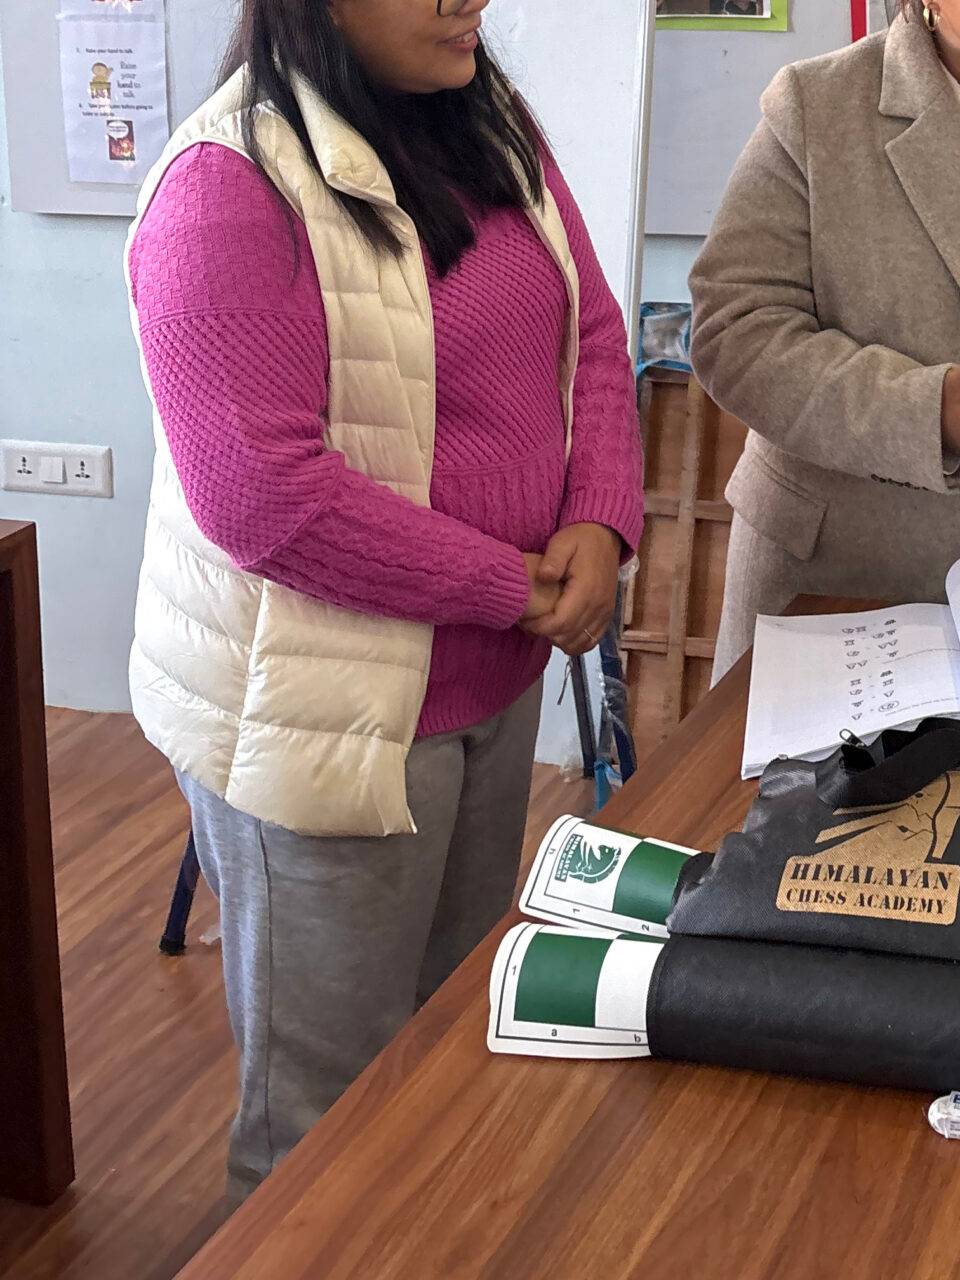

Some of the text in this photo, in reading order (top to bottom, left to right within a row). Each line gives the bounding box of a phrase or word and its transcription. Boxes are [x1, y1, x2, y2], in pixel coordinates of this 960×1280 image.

[790, 862, 953, 892] HIMALAYAN
[785, 887, 948, 915] CHESS ACADEMY
[641, 923, 650, 931] 2
[551, 1028, 558, 1037] a
[634, 1033, 642, 1043] b
